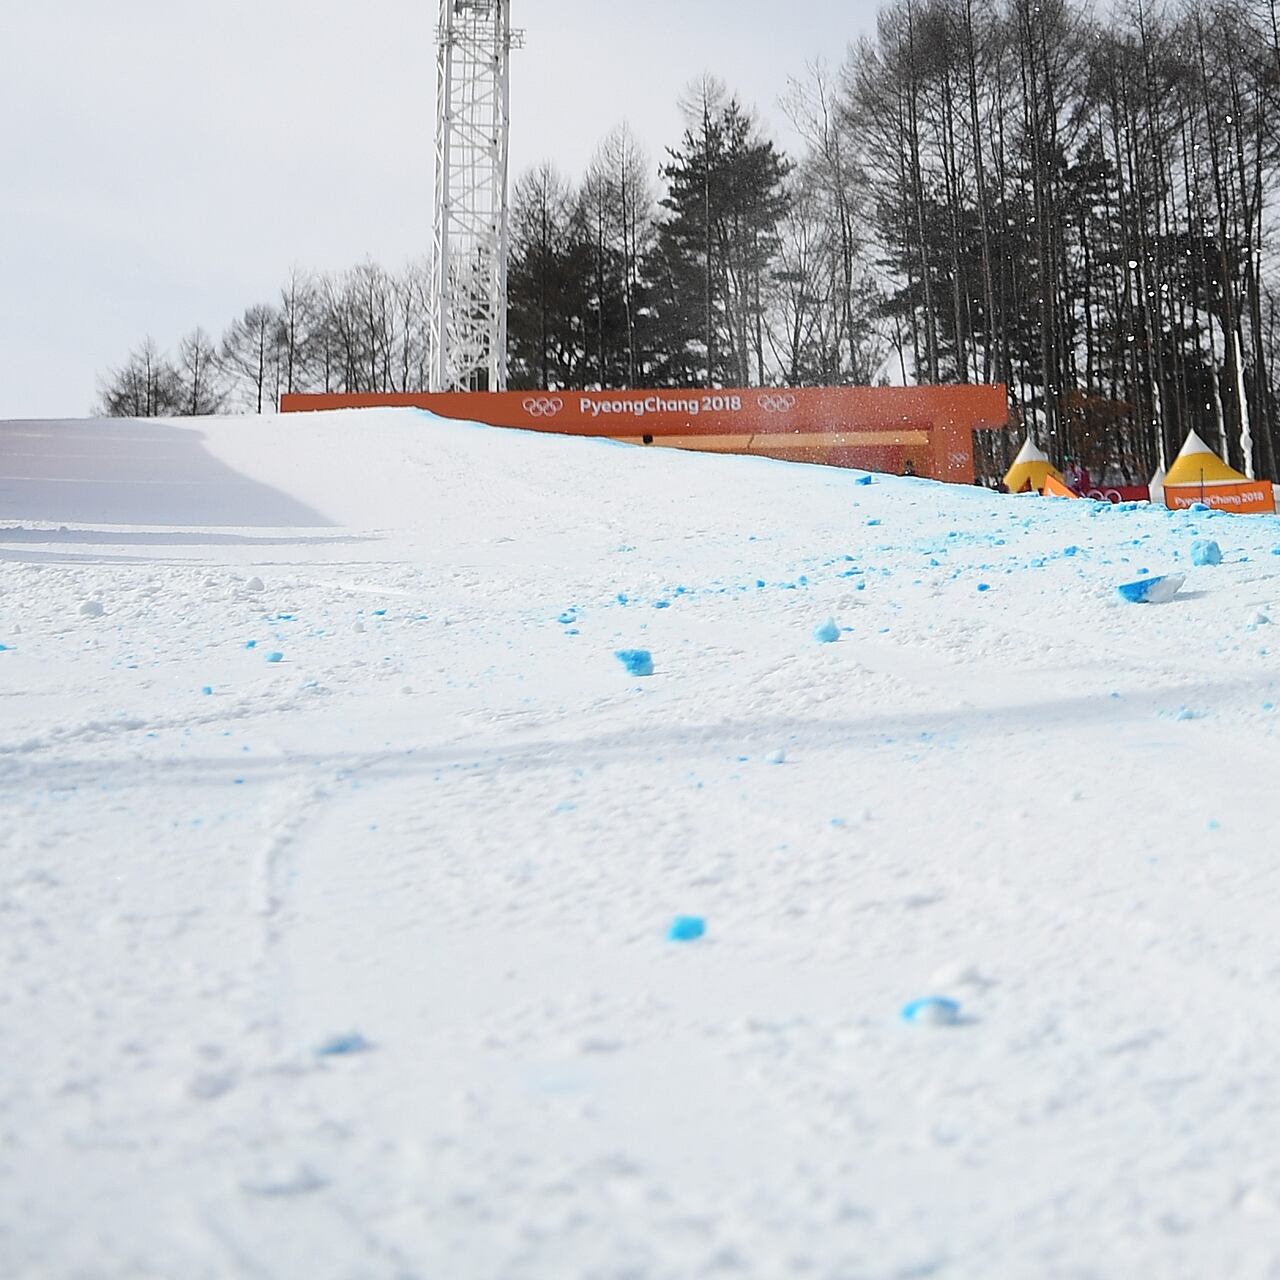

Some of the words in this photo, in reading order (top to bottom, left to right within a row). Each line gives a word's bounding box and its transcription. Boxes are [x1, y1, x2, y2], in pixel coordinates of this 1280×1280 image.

[580, 396, 699, 416] PyeongChang
[702, 395, 742, 412] 2018
[1242, 491, 1264, 504] 2018
